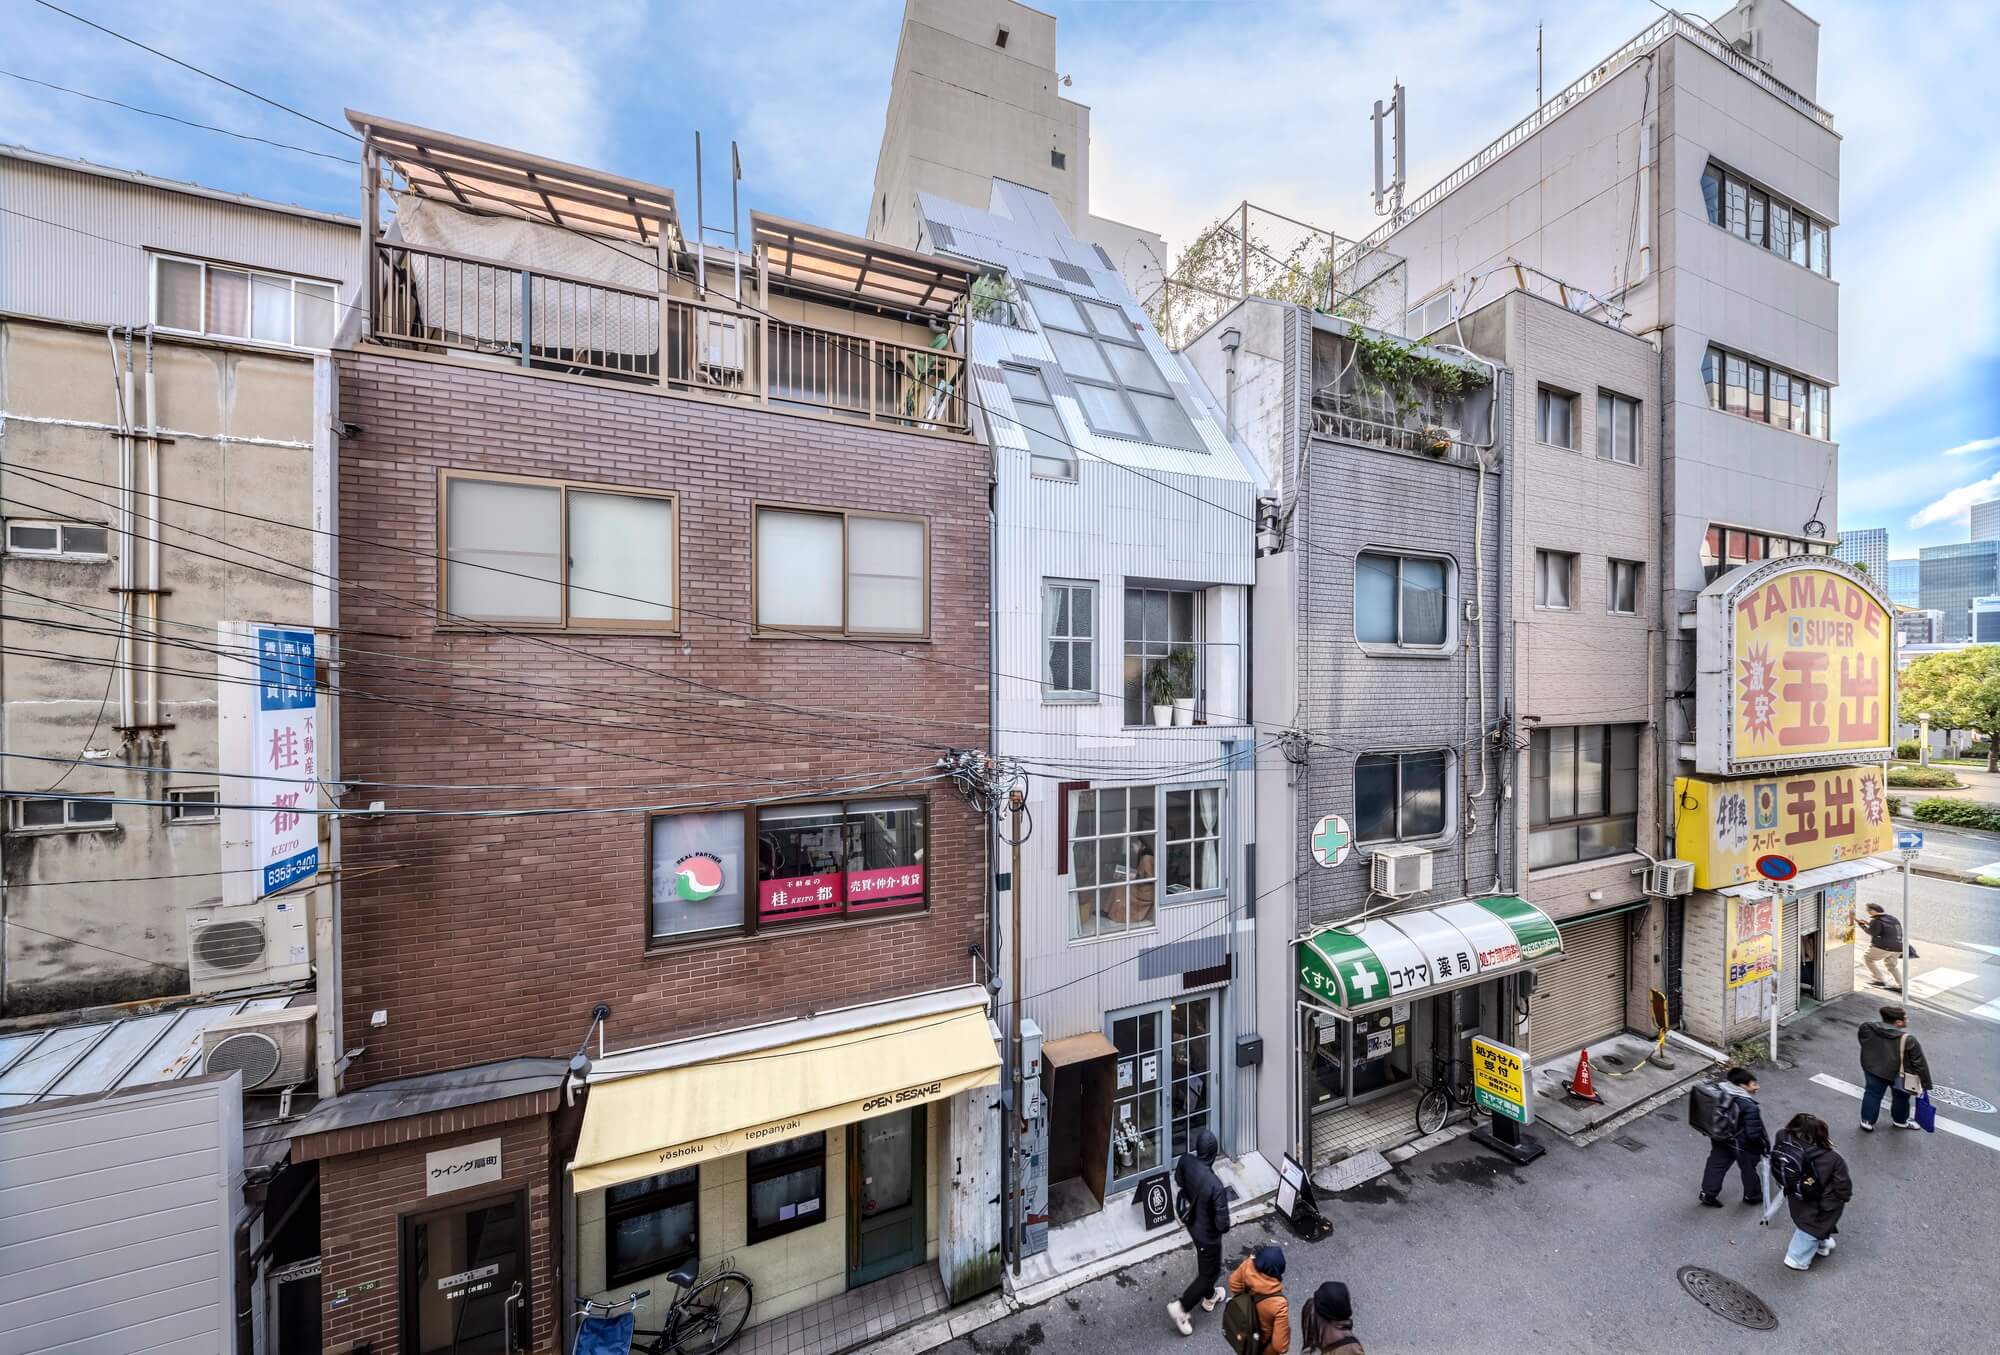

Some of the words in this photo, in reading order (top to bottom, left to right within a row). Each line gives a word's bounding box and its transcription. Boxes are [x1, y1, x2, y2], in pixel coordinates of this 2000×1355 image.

[1737, 575, 1881, 638] TAMADE
[1806, 619, 1854, 648] SUPER
[1750, 660, 1769, 724] 激安
[1778, 651, 1879, 747] 玉出
[303, 717, 316, 795] 不動産の
[268, 726, 301, 836] 桂都
[1784, 775, 1856, 845] 玉出
[271, 839, 299, 857] KEITO
[1752, 831, 1781, 852] スーパー
[268, 854, 316, 886] 6353-3400
[676, 853, 692, 864] REAL
[695, 851, 722, 864] PARTNER
[771, 890, 788, 907] 桂
[816, 886, 833, 901] 都
[787, 878, 820, 888] 不動産の
[791, 895, 814, 905] KEITO
[1301, 966, 1337, 996] くすり
[1390, 952, 1471, 989] コヤマ薬局
[1476, 1045, 1519, 1071] 処方せん
[1484, 1060, 1508, 1077] 受付
[862, 1095, 893, 1112] OPEN
[895, 1083, 942, 1104] SESAME!
[745, 1120, 801, 1140] teppanyaki
[431, 1155, 498, 1178] ウイング扇町
[1153, 1214, 1167, 1224] OPEN
